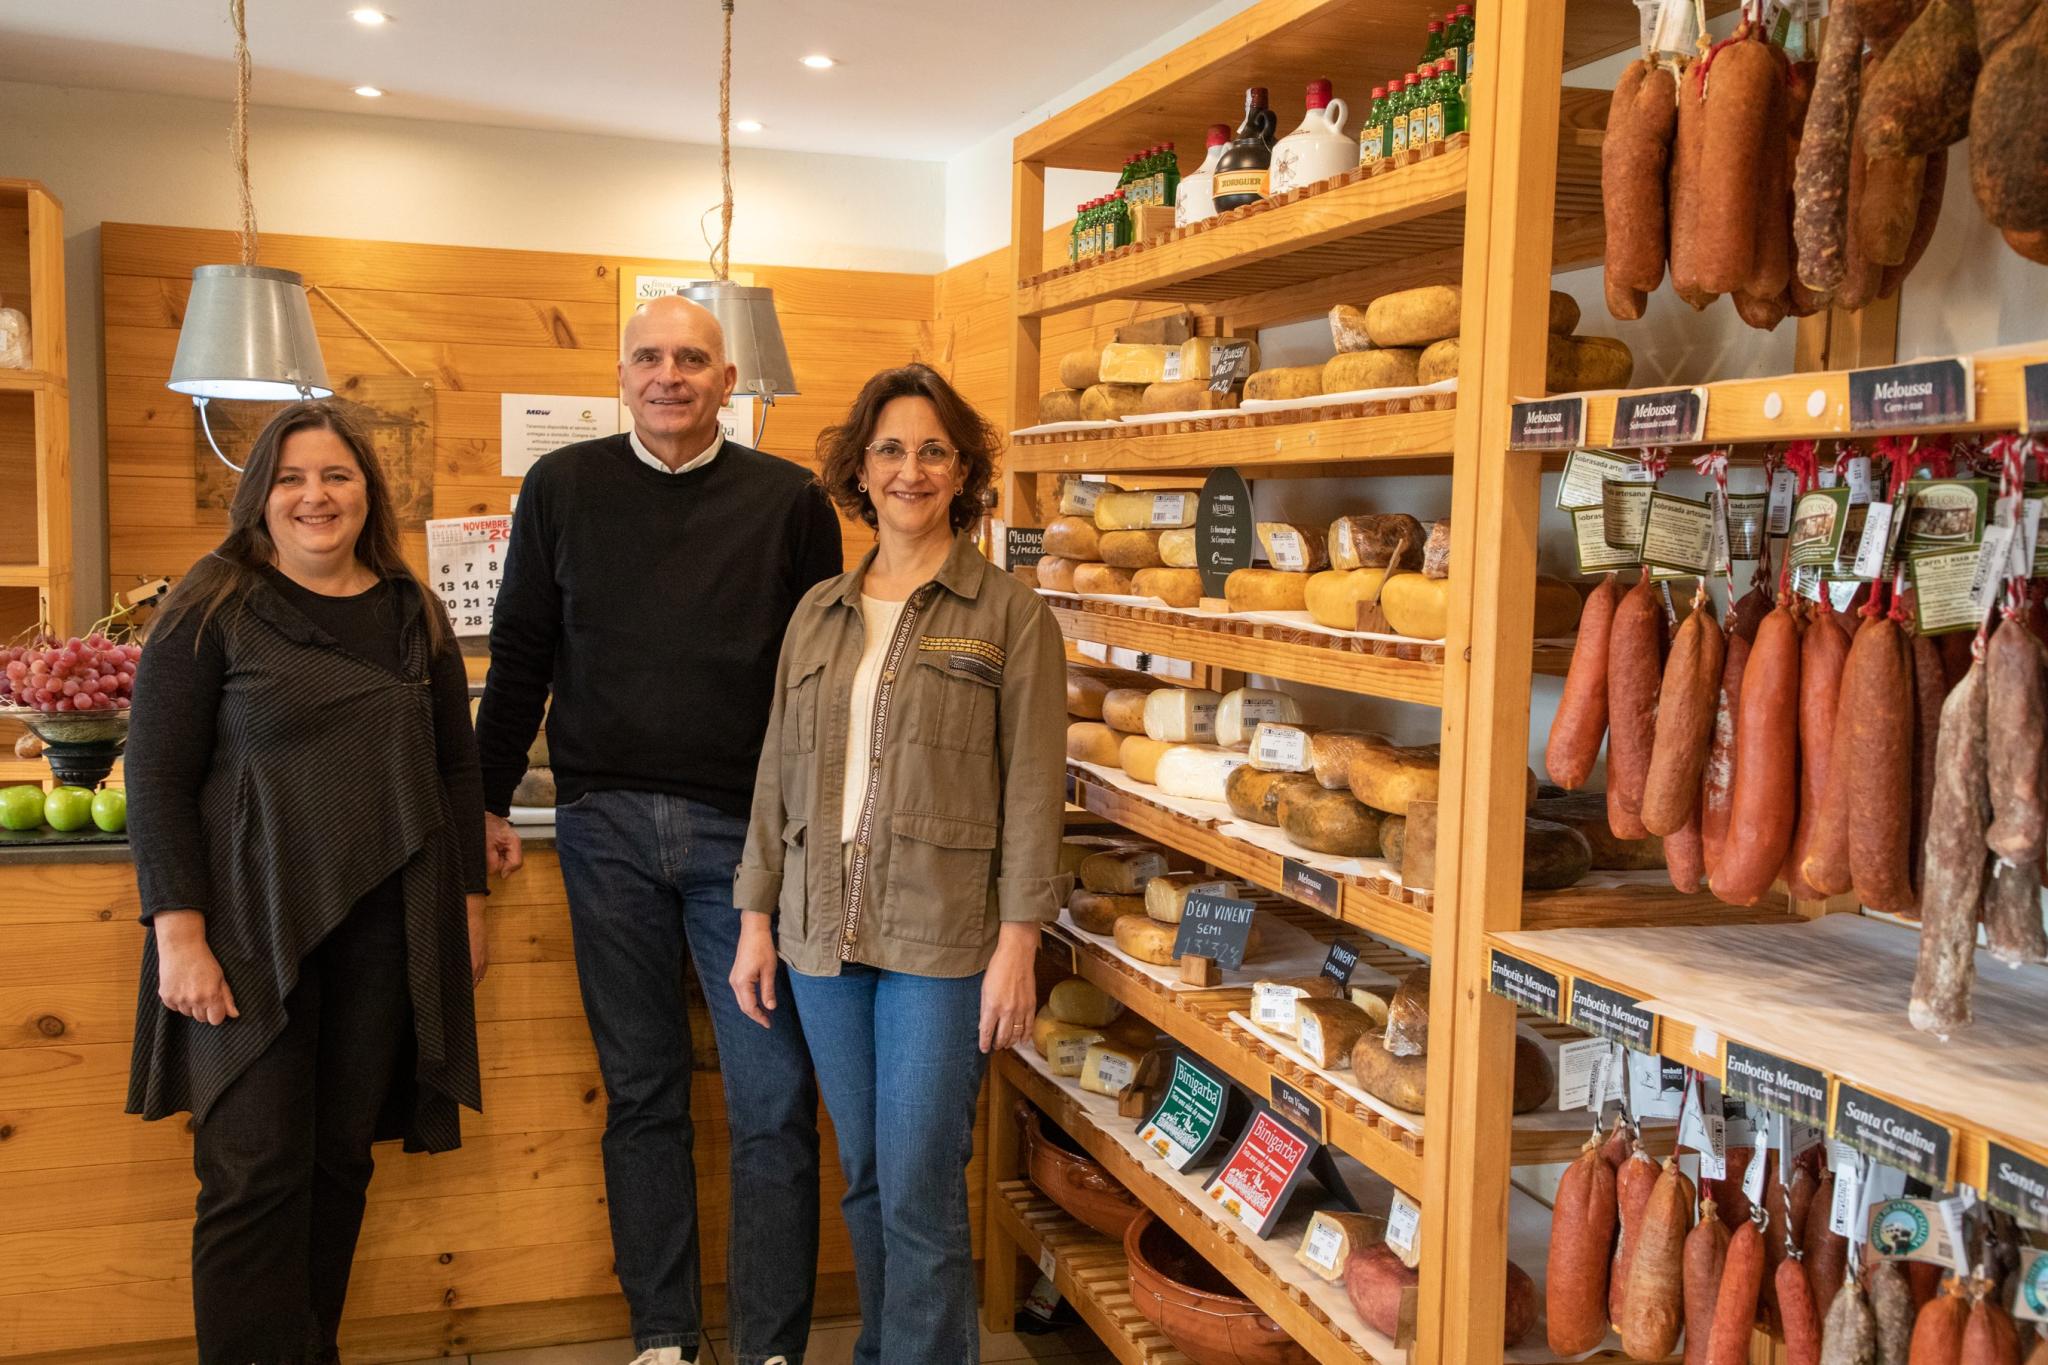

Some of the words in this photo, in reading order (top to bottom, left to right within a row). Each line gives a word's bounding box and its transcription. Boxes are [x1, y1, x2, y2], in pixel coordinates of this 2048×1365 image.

[1874, 380, 1933, 400] Meloussa
[1526, 411, 1562, 424] Meloussa
[1634, 403, 1676, 418] Meloussa
[1654, 501, 1685, 514] Sobrasada
[463, 520, 509, 530] NOVEMBRE
[488, 544, 495, 554] 1
[441, 564, 450, 574] 6
[465, 563, 473, 572] 7
[489, 562, 498, 571] 8
[438, 582, 455, 592] 13
[462, 580, 479, 590] 14
[464, 599, 480, 608] 21
[465, 616, 482, 626] 28
[1298, 872, 1322, 890] Meloussa
[1186, 900, 1211, 918] D'EN
[1214, 904, 1255, 923] VINENT
[1196, 923, 1222, 935] SEMI
[1332, 944, 1357, 967] VINENT
[1492, 960, 1524, 983] Embotits
[1524, 974, 1556, 999] Menorca
[1573, 989, 1610, 1015] Embotits
[1612, 1004, 1649, 1030] Menorca
[1727, 1055, 1774, 1084] Embotits
[1776, 1070, 1823, 1101] Menorca
[1845, 1101, 1880, 1129] Santa
[1882, 1116, 1936, 1154] Catalina
[1998, 1162, 2045, 1199] Santa
